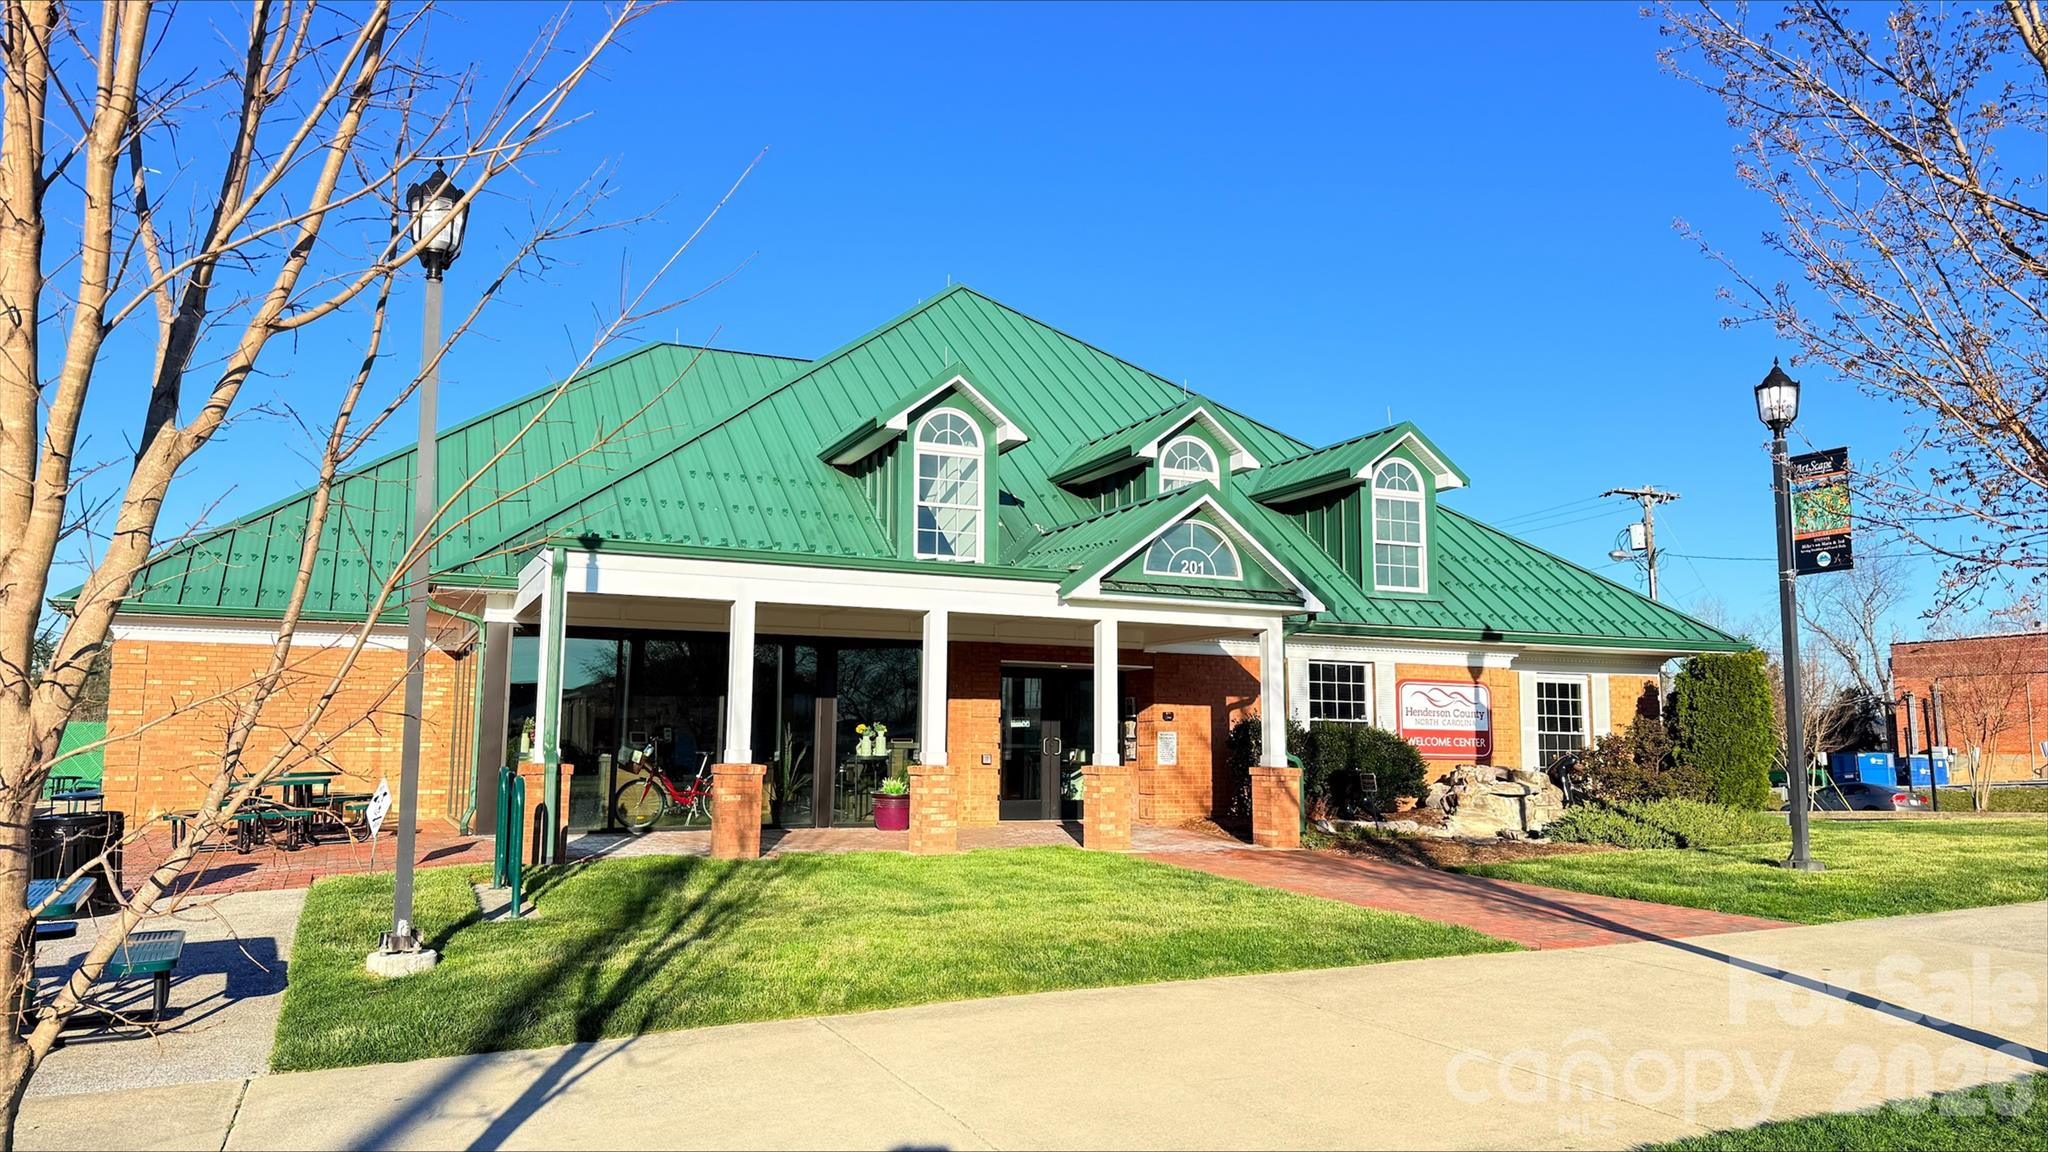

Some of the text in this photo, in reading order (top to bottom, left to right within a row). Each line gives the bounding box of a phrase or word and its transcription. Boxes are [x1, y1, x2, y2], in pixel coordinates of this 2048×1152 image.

[1181, 560, 1204, 575] 201
[1406, 707, 1485, 720] Henderson County
[1415, 718, 1438, 726] NORTH
[1408, 737, 1486, 748] WELCOME CENTER
